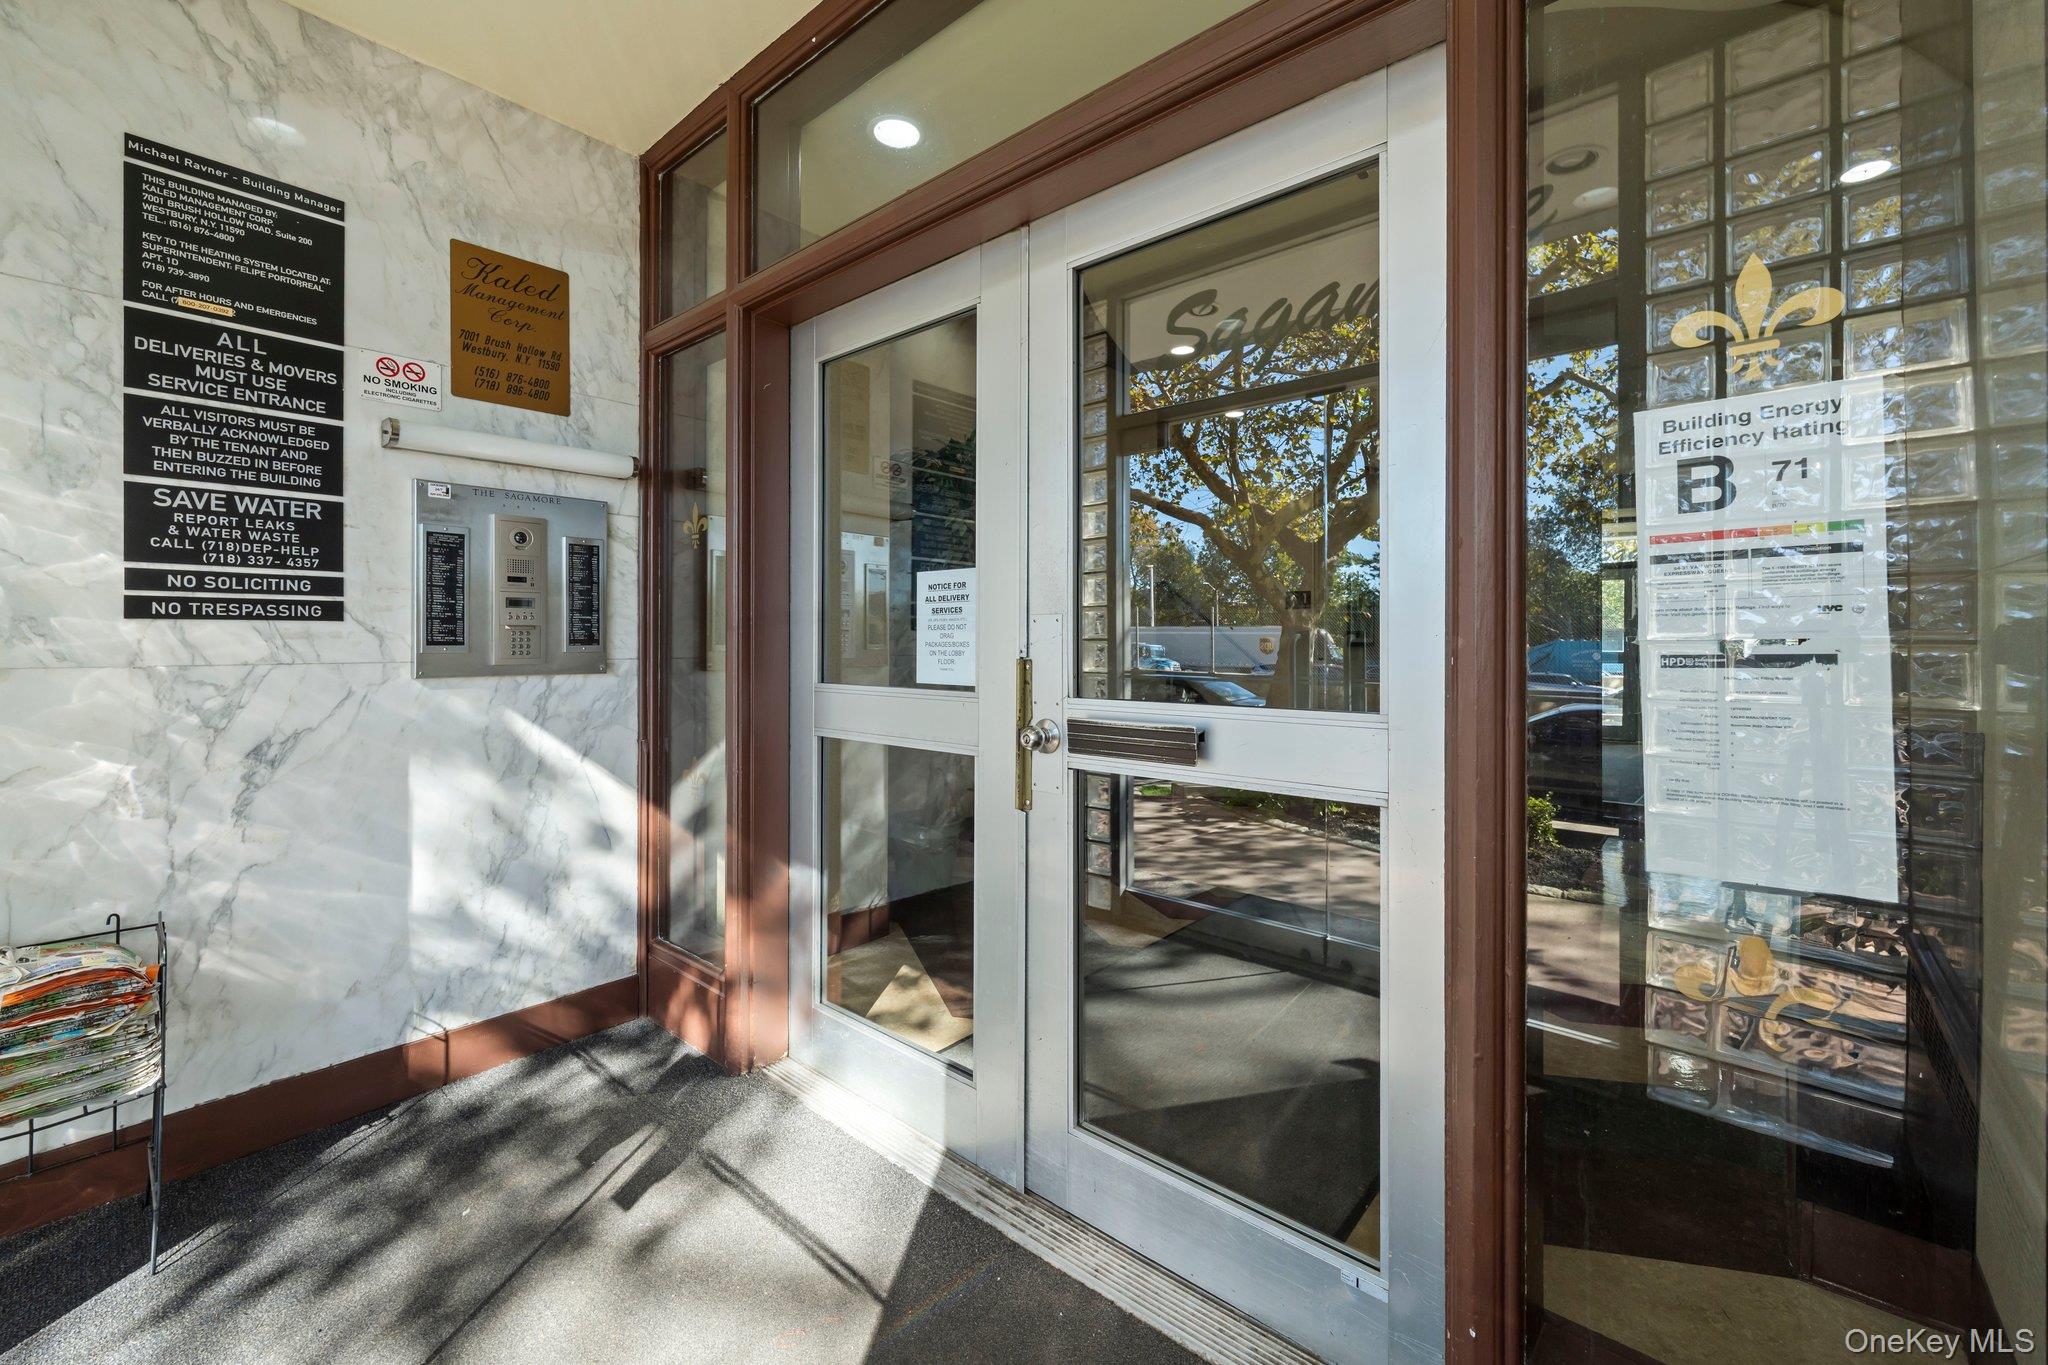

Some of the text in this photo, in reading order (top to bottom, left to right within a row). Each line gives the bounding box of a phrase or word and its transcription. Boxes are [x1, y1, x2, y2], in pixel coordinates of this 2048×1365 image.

[128, 140, 179, 163] Michael
[185, 158, 228, 178] Ravner
[243, 177, 290, 199] Building
[294, 193, 341, 214] Manager
[143, 174, 277, 218] THIS BUILDING MANAGED BY:
[143, 184, 274, 226] KALED MANAGEMENT CORP.
[143, 193, 163, 206] 7001
[168, 200, 201, 215] BRUSH
[204, 210, 243, 226] HOLLOW
[276, 230, 296, 241] Suite
[299, 237, 312, 245] 200
[170, 219, 191, 232] (516)
[194, 226, 234, 243] 876-4800
[200, 218, 217, 229] N.Y.
[220, 224, 245, 236] 11590
[142, 252, 178, 266] APT. 1D
[142, 242, 324, 292] SUPERINTENDENT: FELIPE PORTORREAL
[143, 232, 331, 285] KEY TO THE HEATING SYSTEM LOCATED AT:
[142, 262, 210, 282] (718) 739-3890
[461, 257, 560, 303] Kaled
[142, 290, 168, 302] CALL
[142, 280, 317, 325] FOR AFTER HOURS AND EMERGENCIES
[456, 283, 564, 321] Management
[217, 332, 267, 355] ALL
[460, 329, 479, 341] 7001
[485, 336, 510, 350] Brush
[517, 343, 546, 357] Hollow
[134, 336, 337, 385] DELIVERIES & MOVERS
[515, 354, 530, 366] N.Y.
[538, 359, 560, 372] 11590
[196, 365, 287, 392] MUST USE
[363, 374, 437, 395] NO SMOKING
[474, 366, 550, 389] (516) 876-4800
[474, 378, 550, 400] (718) 896-4800
[148, 374, 326, 414] SERVICE ENTRANCE
[364, 390, 437, 406] ELECTRONIC CIGARETTES
[386, 388, 416, 397] INCLUDING
[161, 405, 316, 436] ALL VISITORS MUST BE
[1663, 397, 1842, 434] Building Energy
[143, 417, 329, 451] VERBALLY ACKNOWLEDGED
[1658, 419, 1848, 455] Efficiency Rating
[152, 446, 322, 475] THEN BUZZED IN BEFORE
[170, 435, 308, 461] BY THE TENANT AND
[153, 461, 321, 488] ENTERING THE BUILDING
[1677, 455, 1808, 514] B 71
[153, 488, 322, 519] SAVE WATER
[473, 489, 562, 504] THE SAGAMORE
[168, 526, 300, 543] & WATER WASTE
[174, 513, 295, 531] REPORT LEAKS
[150, 538, 194, 549] CALL
[203, 554, 240, 565] (718)
[287, 558, 319, 568] 4357
[167, 575, 311, 592] NO SOLICITING
[152, 602, 322, 617] NO TRESPASSING
[1661, 658, 1685, 666] HPD
